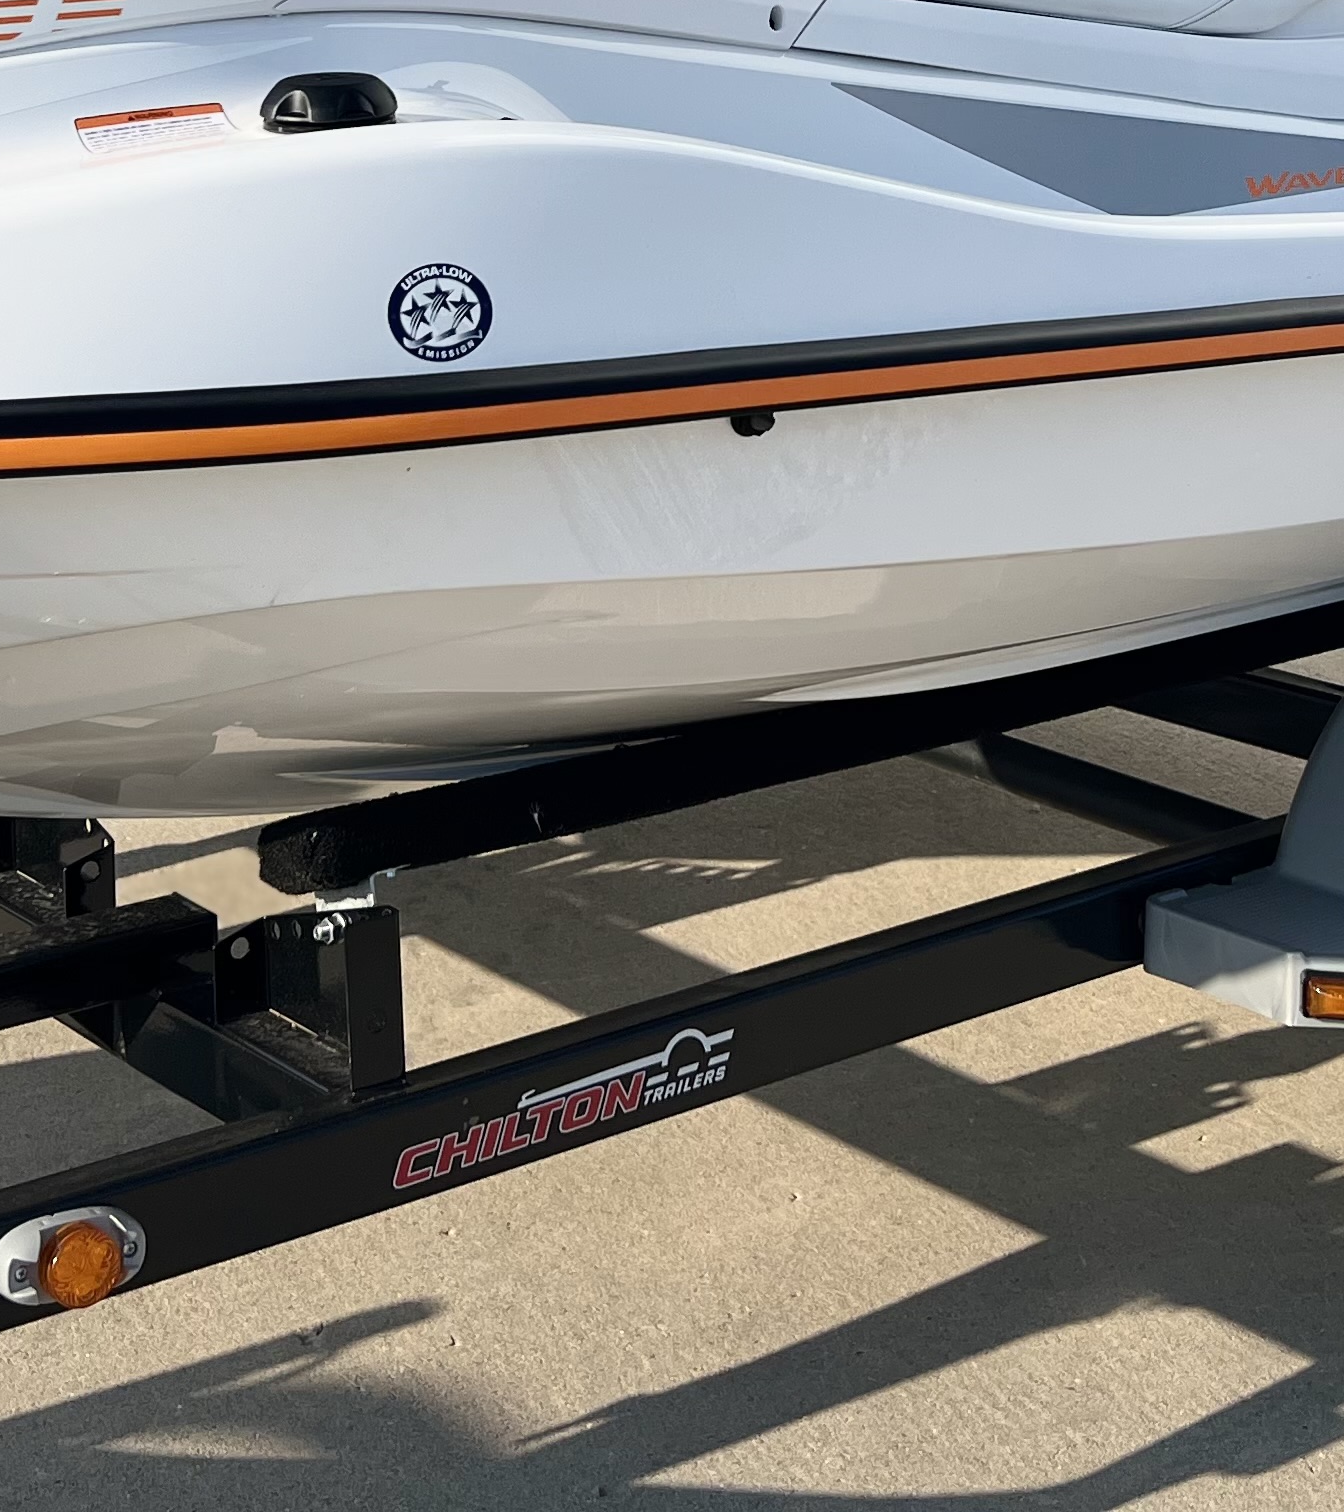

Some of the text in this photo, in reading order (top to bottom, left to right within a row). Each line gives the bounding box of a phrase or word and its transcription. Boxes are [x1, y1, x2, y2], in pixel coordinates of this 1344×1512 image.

[418, 339, 475, 359] EMISSION
[644, 1064, 727, 1106] TRAILERS
[393, 1070, 647, 1190] CHILTON
